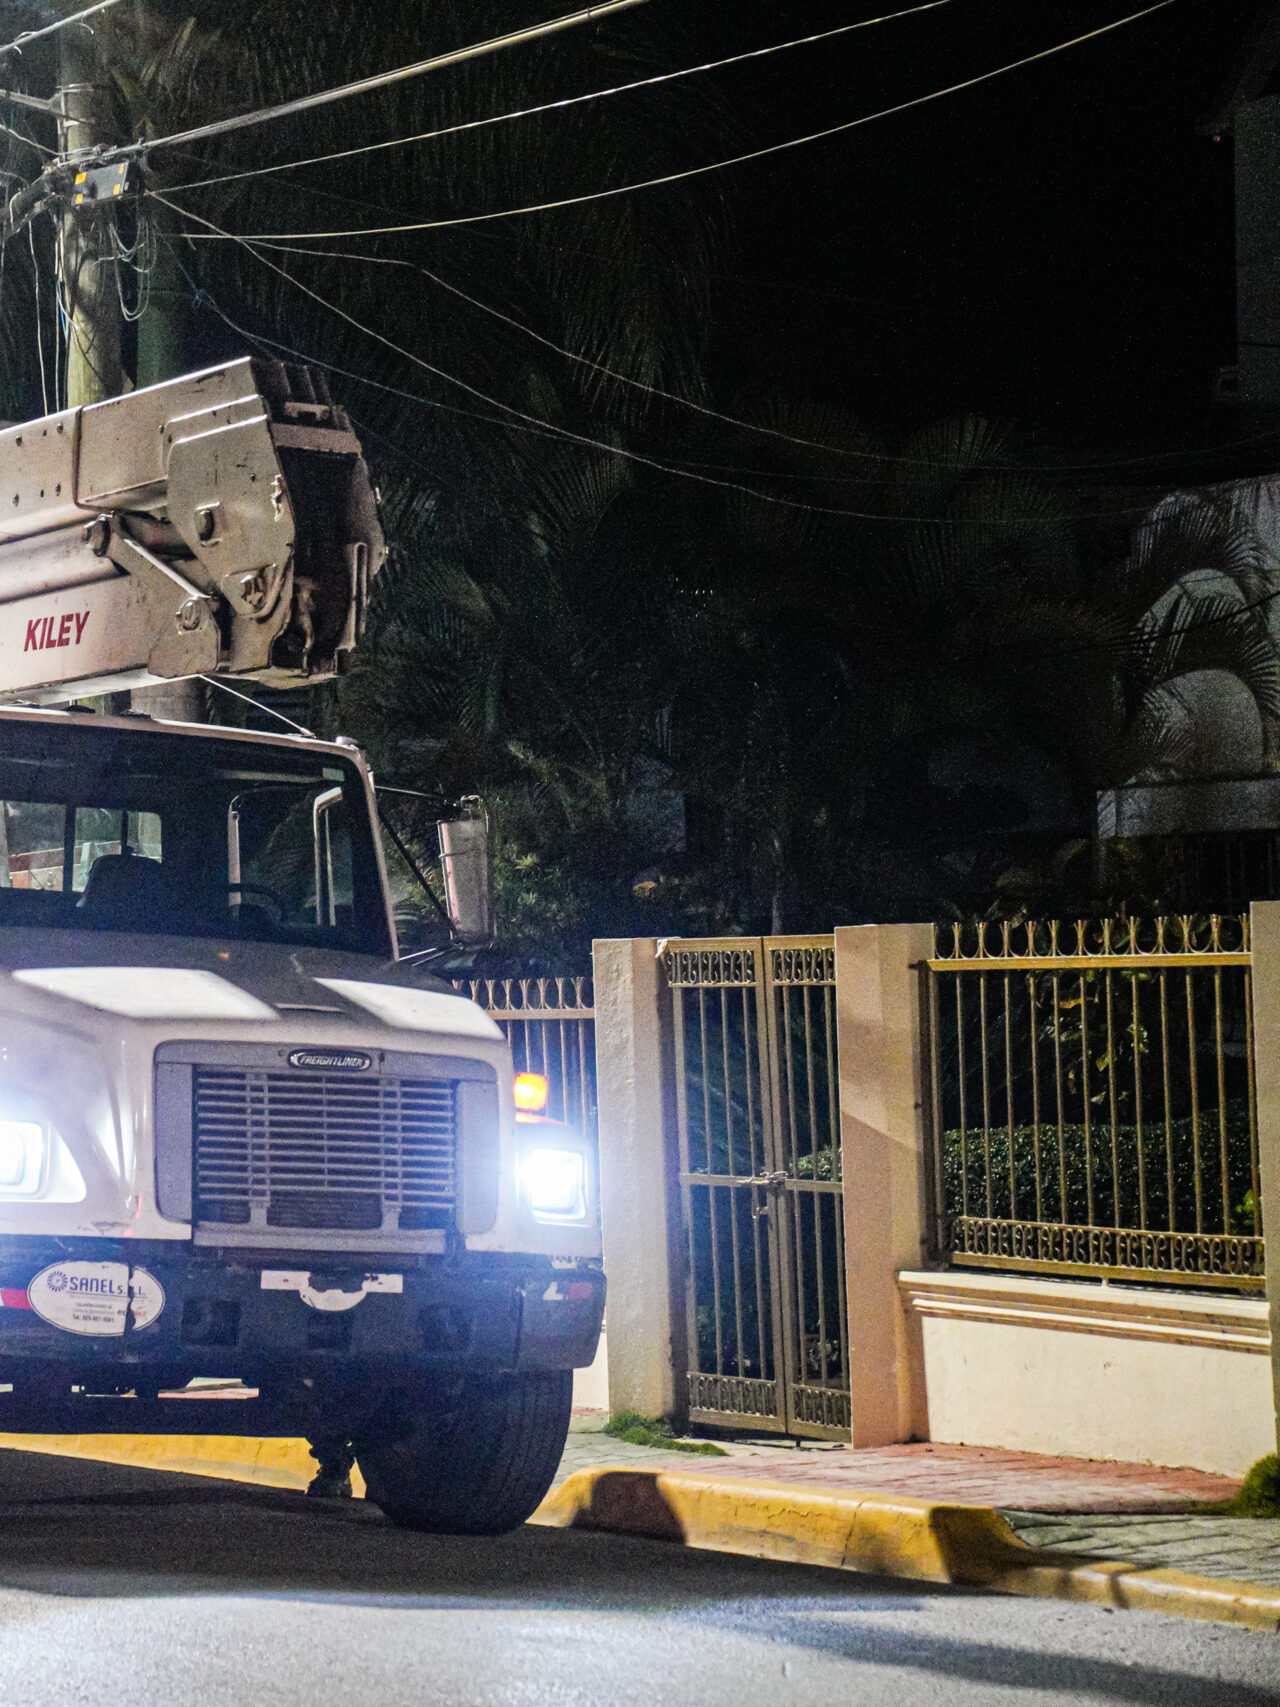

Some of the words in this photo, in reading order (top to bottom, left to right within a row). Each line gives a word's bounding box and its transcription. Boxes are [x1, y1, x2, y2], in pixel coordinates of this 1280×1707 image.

[23, 610, 91, 652] KILEY
[299, 1055, 363, 1067] FREIGHTLINER
[69, 1276, 115, 1294] SANEL
